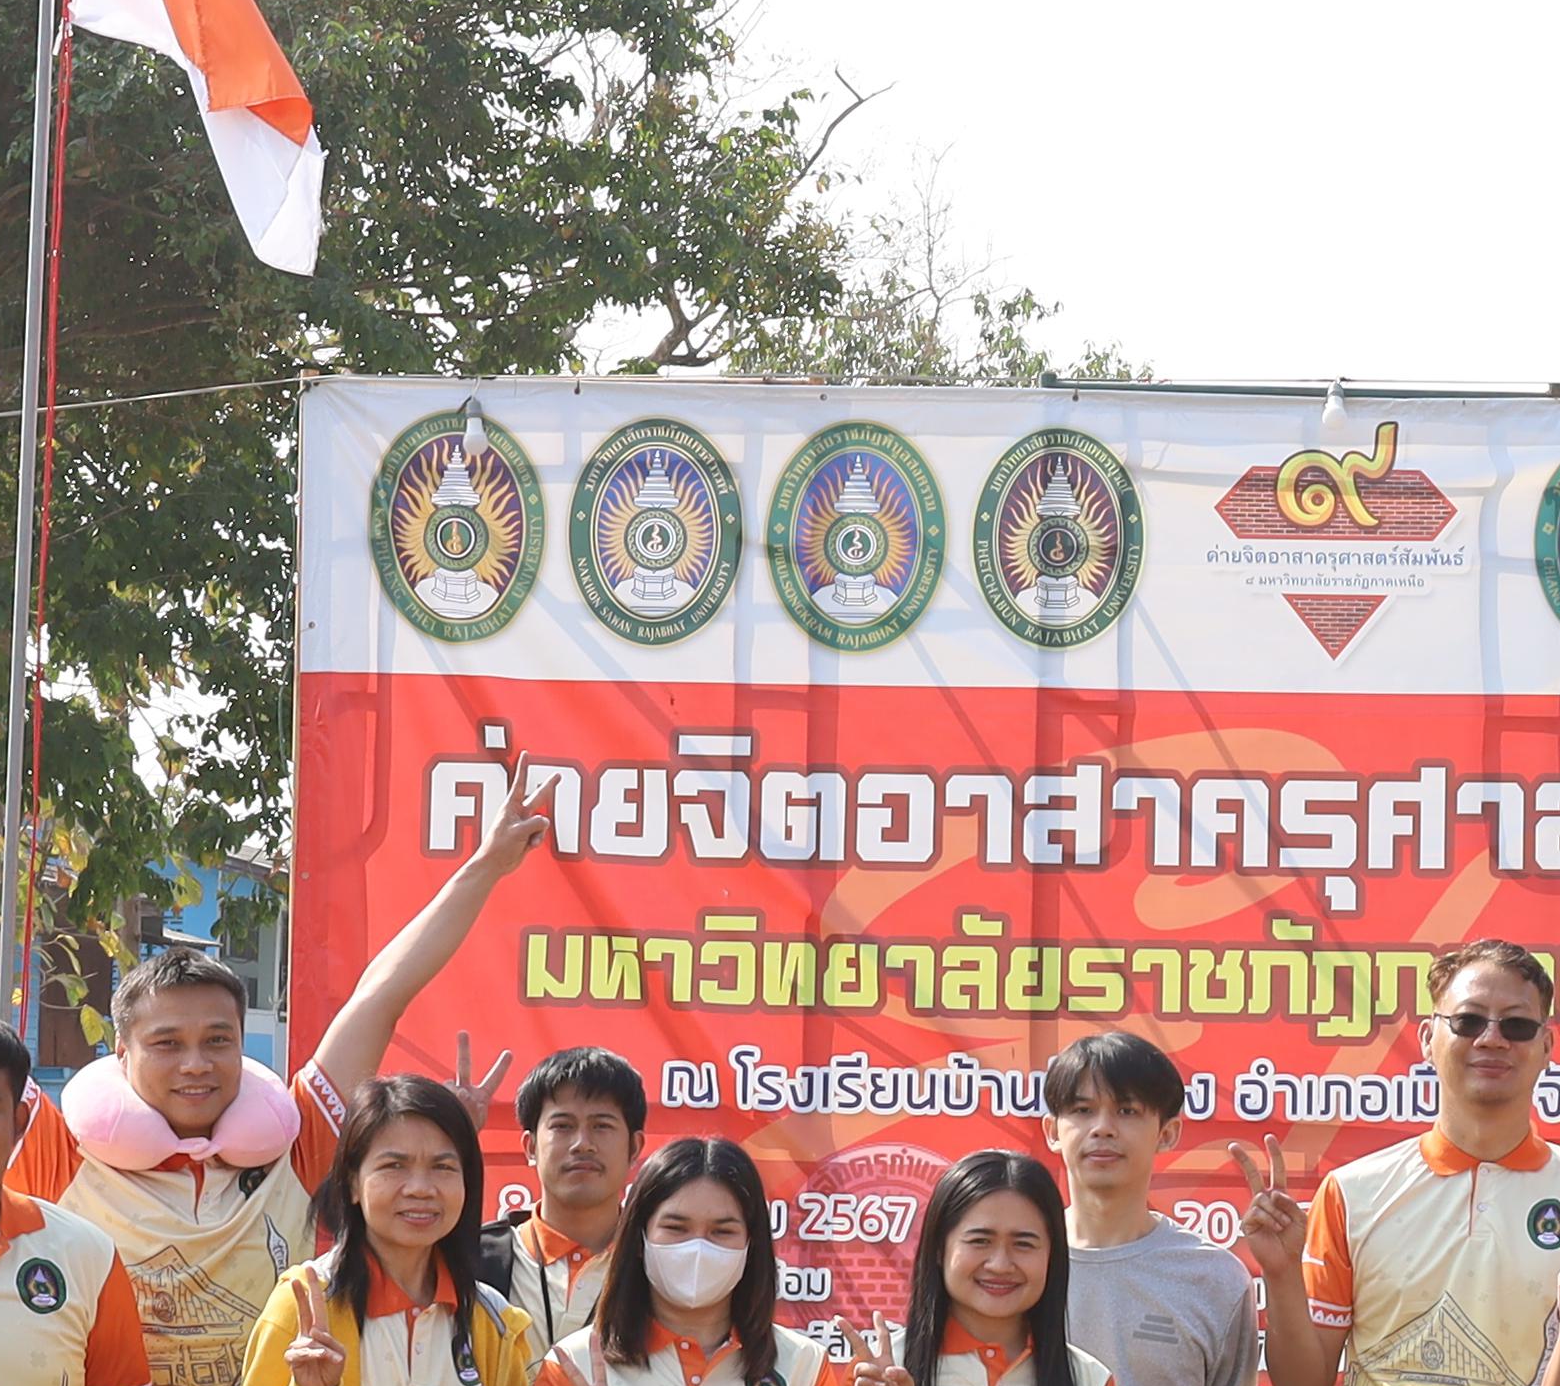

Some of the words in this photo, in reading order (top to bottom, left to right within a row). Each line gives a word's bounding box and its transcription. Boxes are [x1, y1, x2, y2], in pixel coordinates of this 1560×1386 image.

[1275, 421, 1398, 530] ๙
[407, 602, 437, 631] PHET
[443, 603, 514, 642] RAJABHAT
[513, 516, 542, 600] UNIVERSITY
[577, 556, 602, 610] NAKHON
[599, 606, 633, 634] SAWAN
[637, 619, 686, 644] RAJABHAT
[692, 561, 731, 625] UNIVERSITY
[837, 619, 900, 650] RAJABHAT
[900, 547, 938, 622] UNIVERSITY
[976, 540, 1021, 627] PHETCHABUN
[1024, 618, 1101, 646] RAJABHAT
[1103, 543, 1141, 618] UNIVERSITY
[1207, 545, 1465, 572] ค่ายจิตอาสาครุศาสตร์สัมพันธ์
[666, 1065, 717, 1105] ณ
[800, 1194, 916, 1241] 2567
